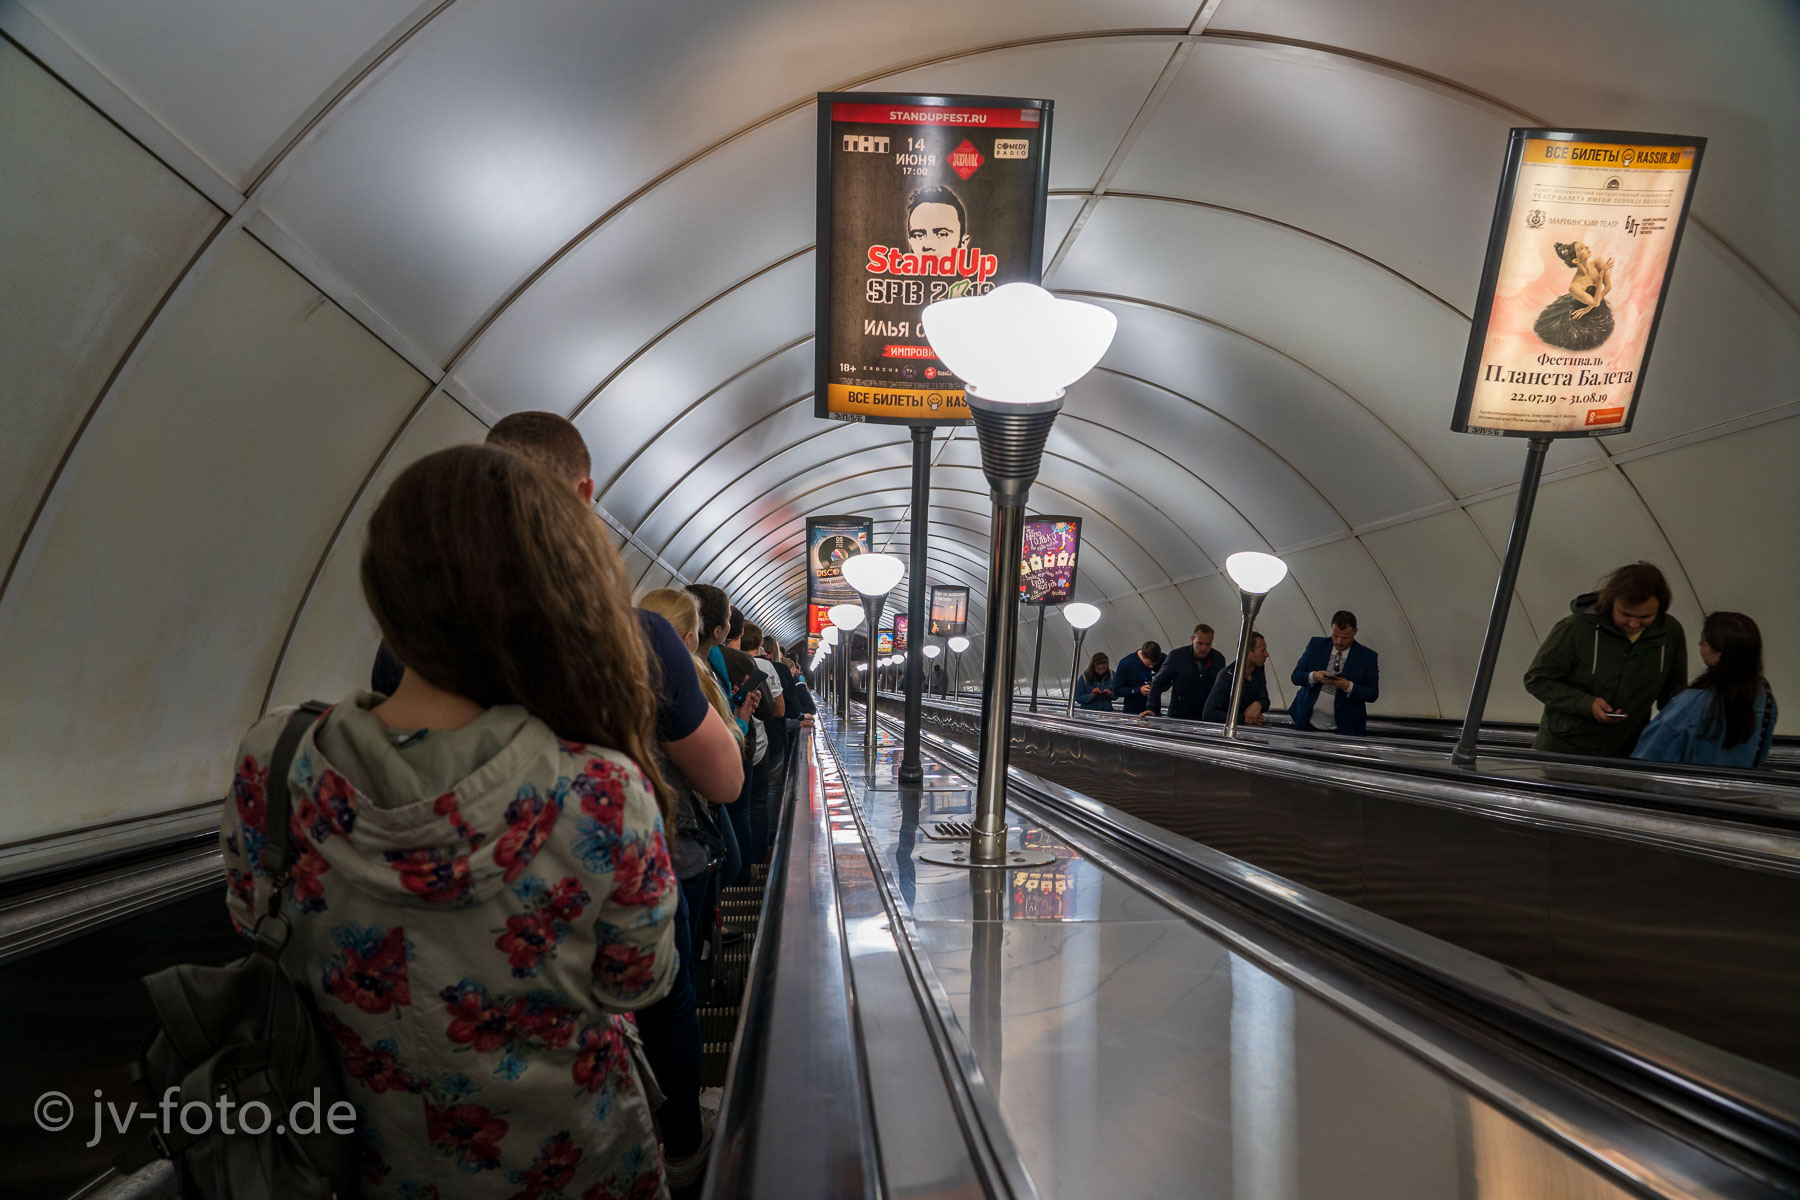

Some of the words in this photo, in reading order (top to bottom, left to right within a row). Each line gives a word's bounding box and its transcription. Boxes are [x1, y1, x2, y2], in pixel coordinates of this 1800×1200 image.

[889, 110, 987, 124] STANDUPFEST.RU
[907, 137, 926, 152] 14
[895, 153, 937, 167] ИЮНЯ
[1545, 145, 1569, 159] ВСЕ
[1571, 147, 1620, 163] БИЛЕТЫ
[1636, 151, 1682, 165] KASSIR.RU
[902, 167, 929, 176] 17:00
[866, 244, 998, 283] StandUp
[866, 278, 925, 306] SPB
[864, 319, 910, 338] ИЛЬЯ
[890, 346, 936, 358] ИМПРОВИ
[1537, 352, 1604, 366] Фестиваль
[839, 362, 857, 374] 18+
[1484, 364, 1573, 386] Планета
[1577, 369, 1634, 387] Балета
[848, 391, 870, 405] ВСЕ
[873, 393, 924, 408] БИЛЕТЫ
[946, 395, 967, 408] KAS
[1510, 392, 1557, 405] 22.07.19
[1570, 392, 1608, 406] 31.08.19
